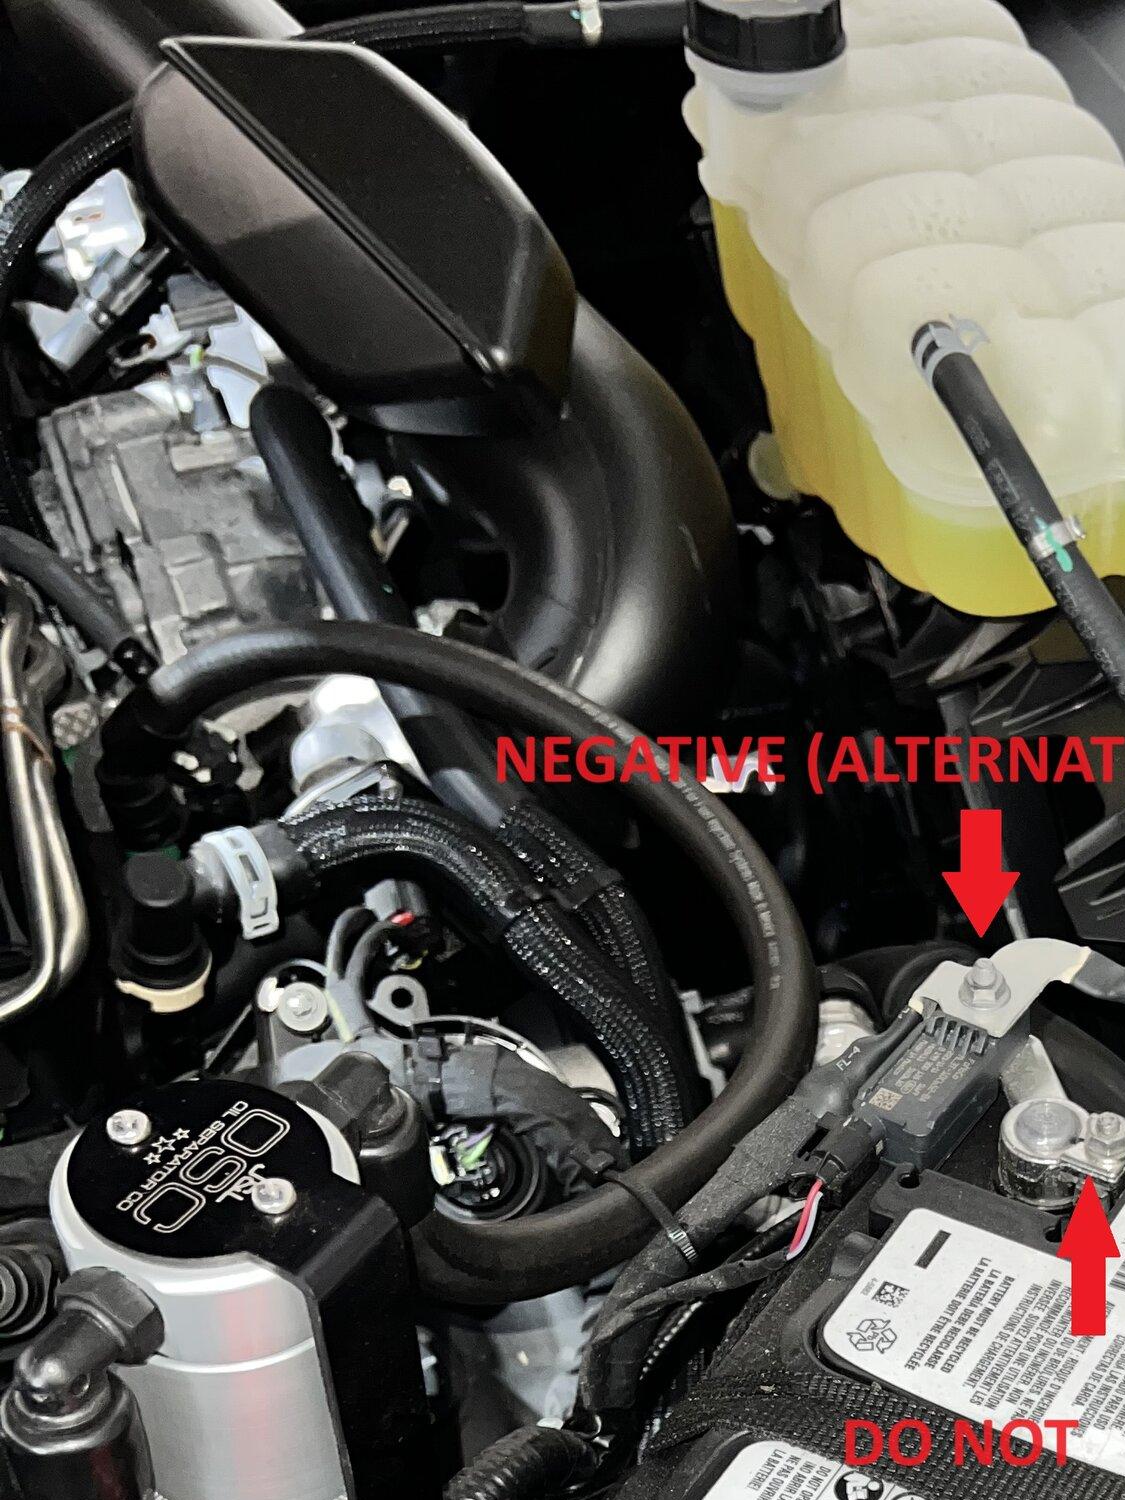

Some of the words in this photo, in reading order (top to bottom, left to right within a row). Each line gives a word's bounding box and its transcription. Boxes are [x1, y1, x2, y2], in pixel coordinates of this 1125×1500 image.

[221, 1100, 249, 1118] OIL
[140, 1120, 226, 1191] SEPARATOR
[133, 1108, 291, 1234] OSC
[115, 1188, 144, 1212] CO
[985, 1267, 1002, 1279] LA
[965, 1277, 998, 1310] BATERÍA
[984, 1274, 1015, 1308] BATTERY
[952, 1306, 975, 1327] DEBE
[971, 1305, 994, 1327] MUST
[964, 1325, 980, 1337] BE
[923, 1325, 962, 1370] RECICLARSE
[939, 1335, 973, 1374] RECYCLED
[769, 1448, 786, 1460] LA
[783, 1453, 801, 1466] NE
[745, 1456, 780, 1492] BATTERIE!
[774, 1462, 795, 1479] PAS
[813, 1464, 831, 1477] DO
[803, 1474, 824, 1491] NOT
